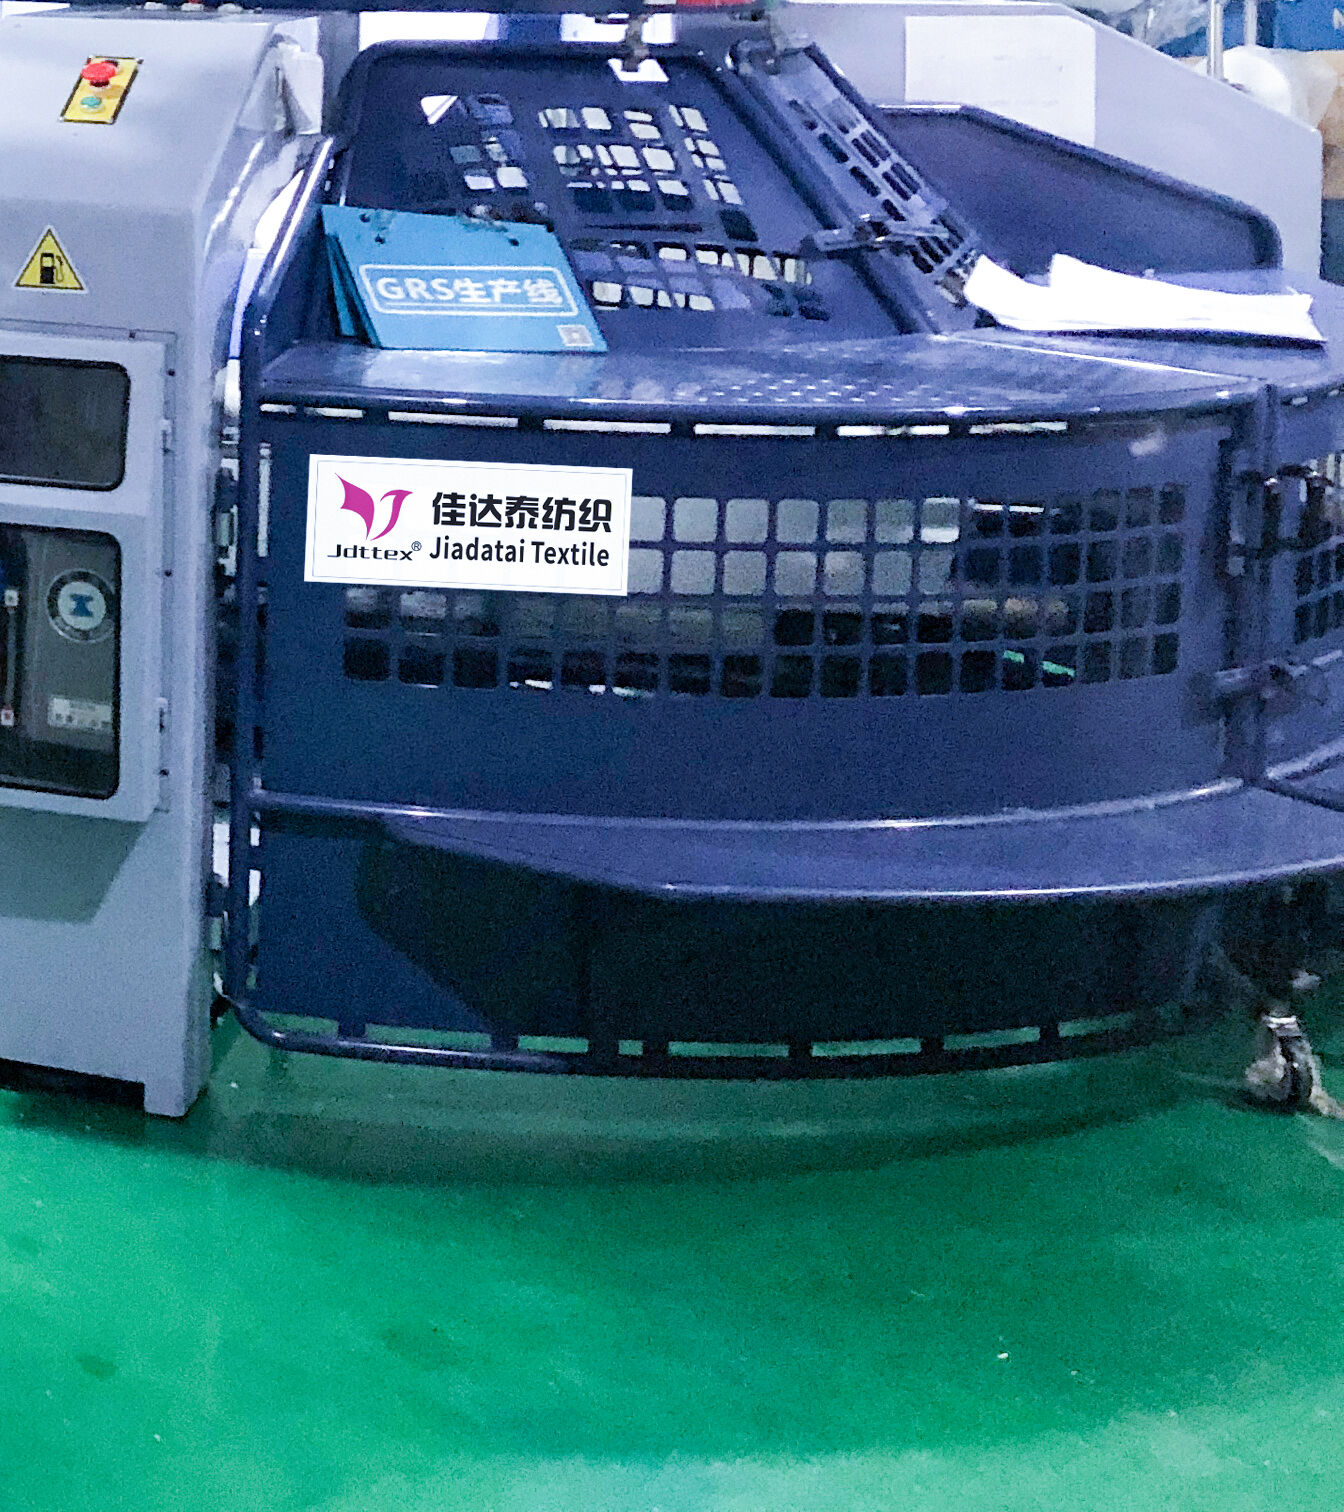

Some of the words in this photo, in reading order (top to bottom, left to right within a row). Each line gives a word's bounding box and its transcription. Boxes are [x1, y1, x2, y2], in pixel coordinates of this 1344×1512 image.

[376, 277, 563, 305] GRS生产线
[432, 491, 612, 533] 佳达泰纺织
[429, 535, 525, 563] Jiadatai
[531, 541, 610, 567] Textile
